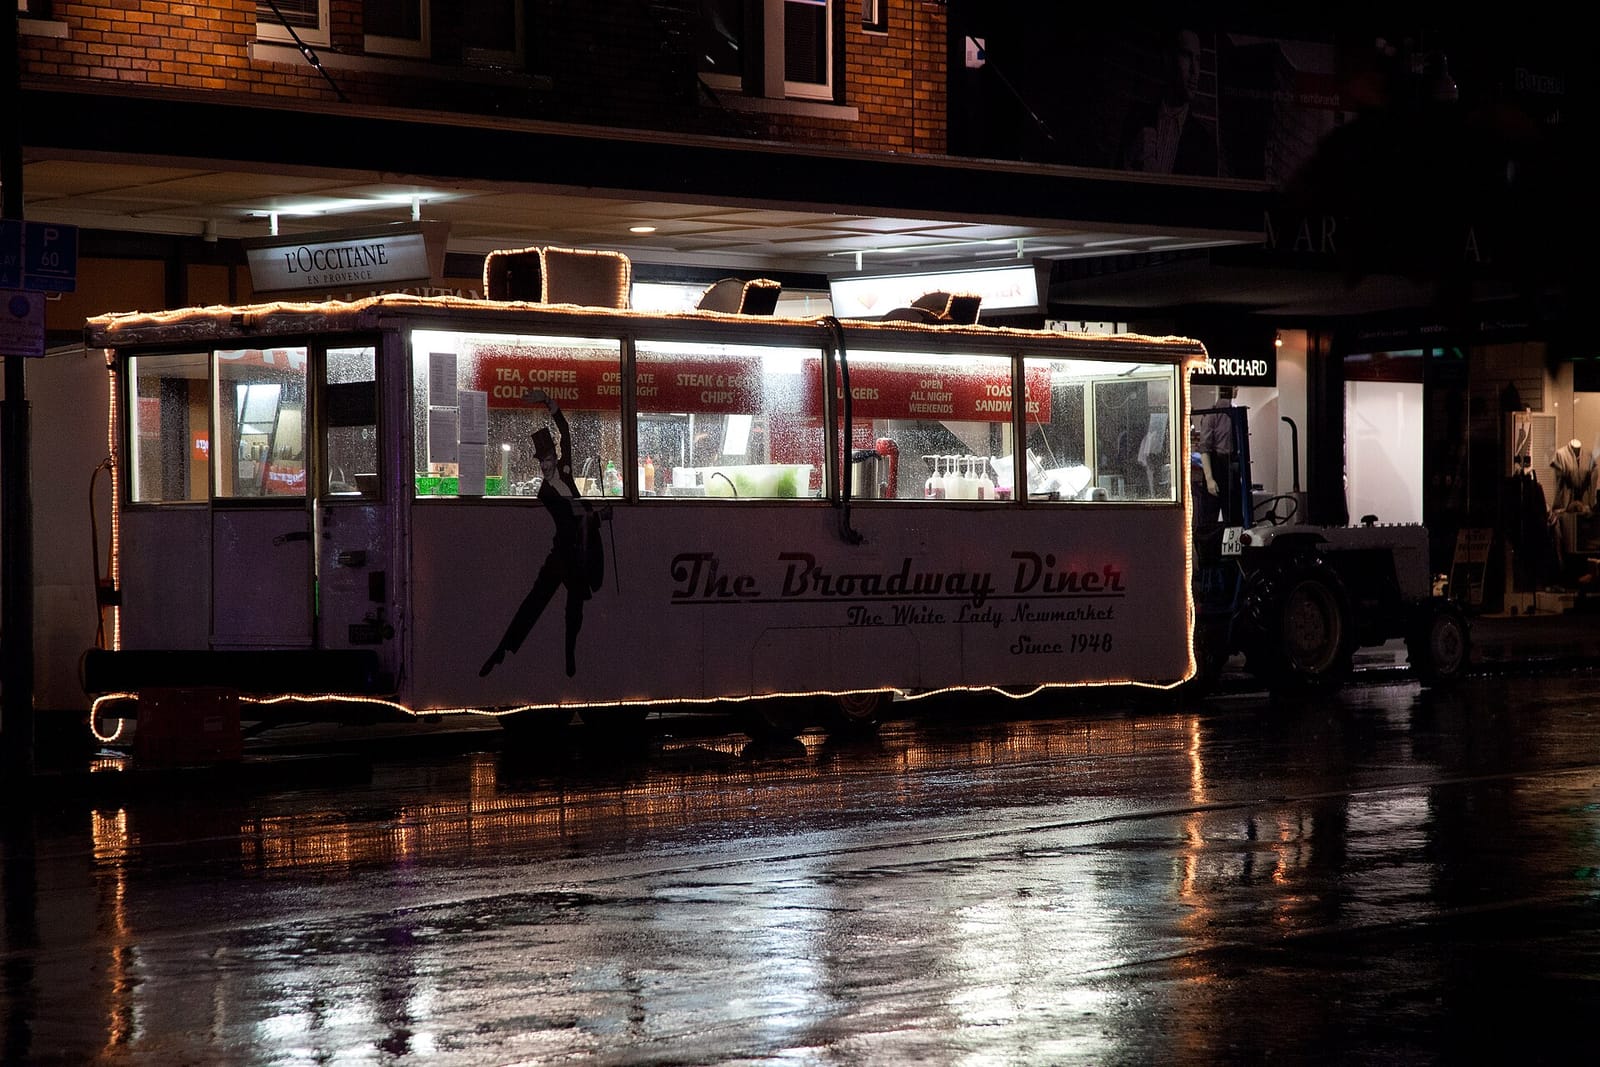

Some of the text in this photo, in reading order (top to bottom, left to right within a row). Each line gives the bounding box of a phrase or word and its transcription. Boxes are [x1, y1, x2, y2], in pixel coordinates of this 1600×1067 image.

[43, 227, 59, 247] P
[41, 251, 60, 266] 60
[285, 244, 388, 273] L'OCCITANE
[307, 271, 373, 285] EN PROVENCE
[1218, 358, 1268, 376] RICHARD
[495, 368, 577, 383] TEA, COFFEE
[676, 374, 713, 387] STEAK
[716, 375, 724, 387] &
[597, 385, 659, 397] EVER IGHT
[920, 379, 943, 390] OPEN
[493, 385, 579, 400] COLD RINKS
[700, 391, 734, 404] CHIPS
[910, 391, 953, 402] ALL NIGHT
[908, 403, 954, 414] WEEKENDS
[1223, 542, 1241, 553] TMD
[670, 551, 1126, 608] The Broadway Diner
[847, 603, 1113, 628] The White Lady Newmarket
[1010, 633, 1113, 655] Since 1948
